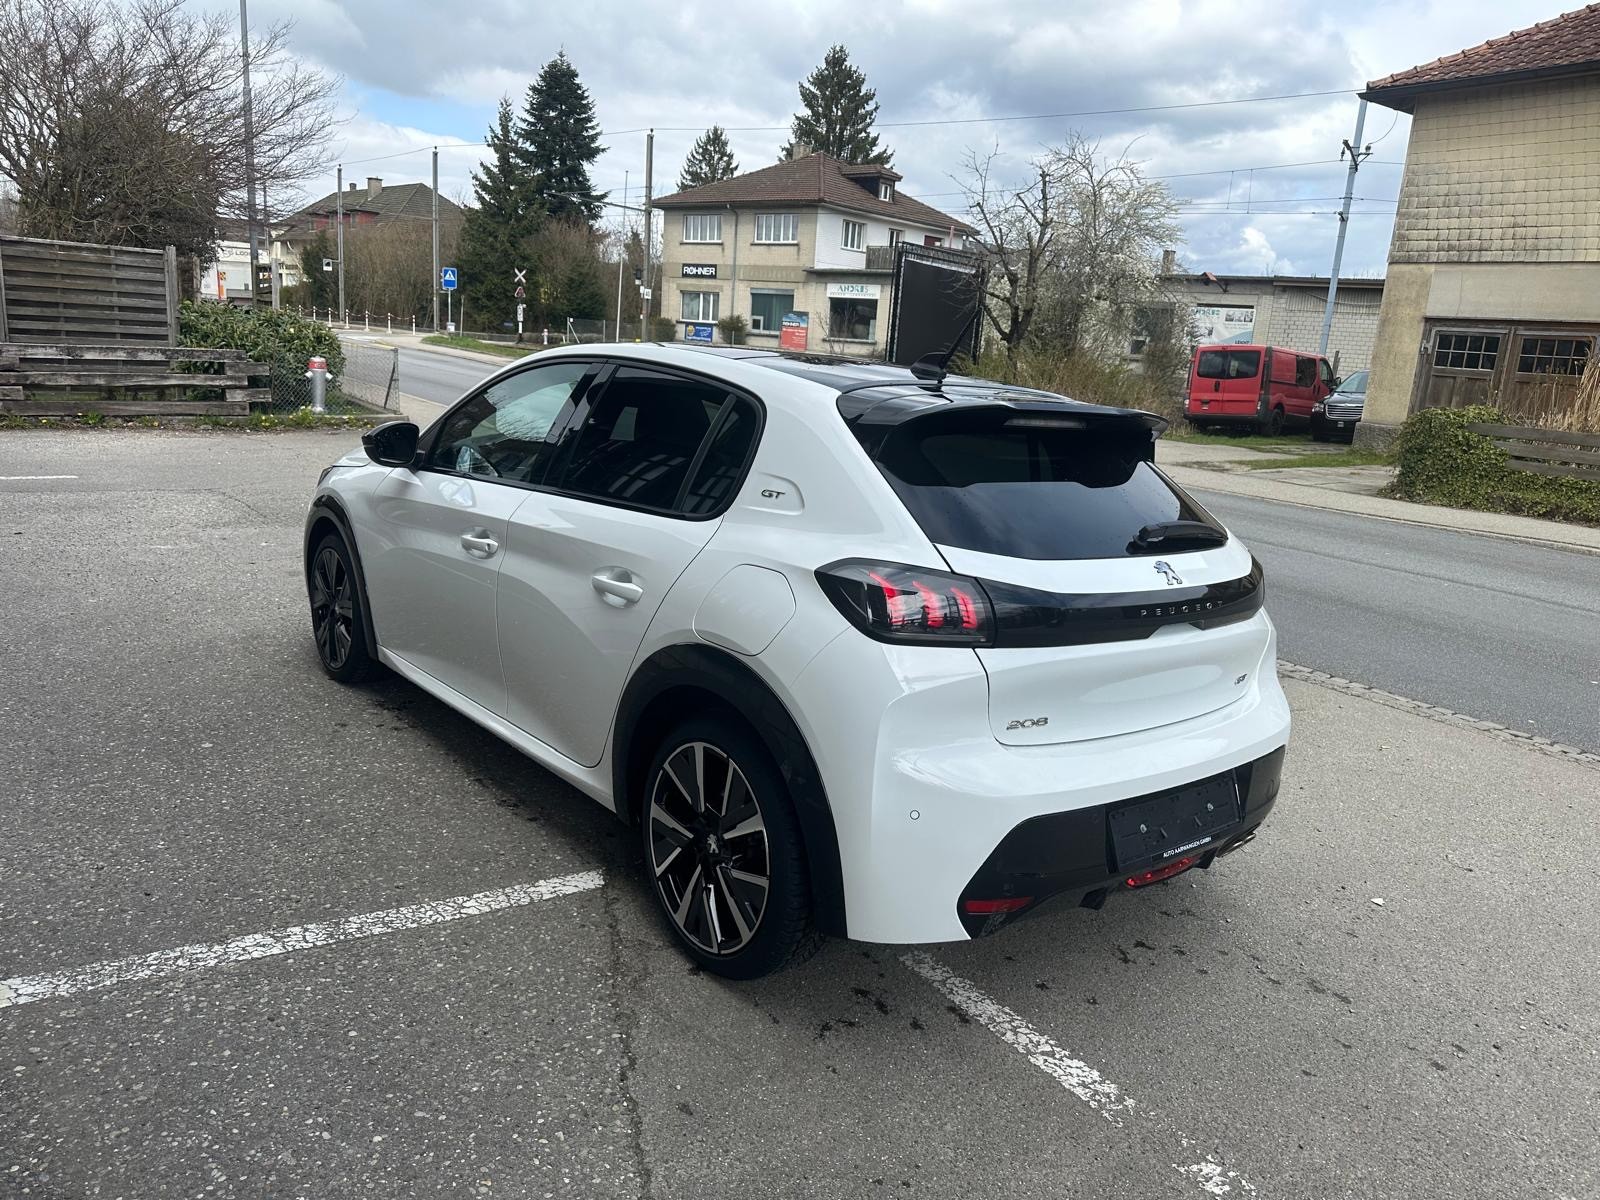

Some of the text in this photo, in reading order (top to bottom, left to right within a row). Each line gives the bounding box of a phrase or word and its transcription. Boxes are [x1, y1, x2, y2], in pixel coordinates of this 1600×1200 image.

[683, 266, 716, 276] ROHNER
[760, 488, 786, 499] GT
[1139, 600, 1224, 617] PEUGEOT
[1006, 717, 1049, 731] 208
[1163, 850, 1175, 858] AUTO
